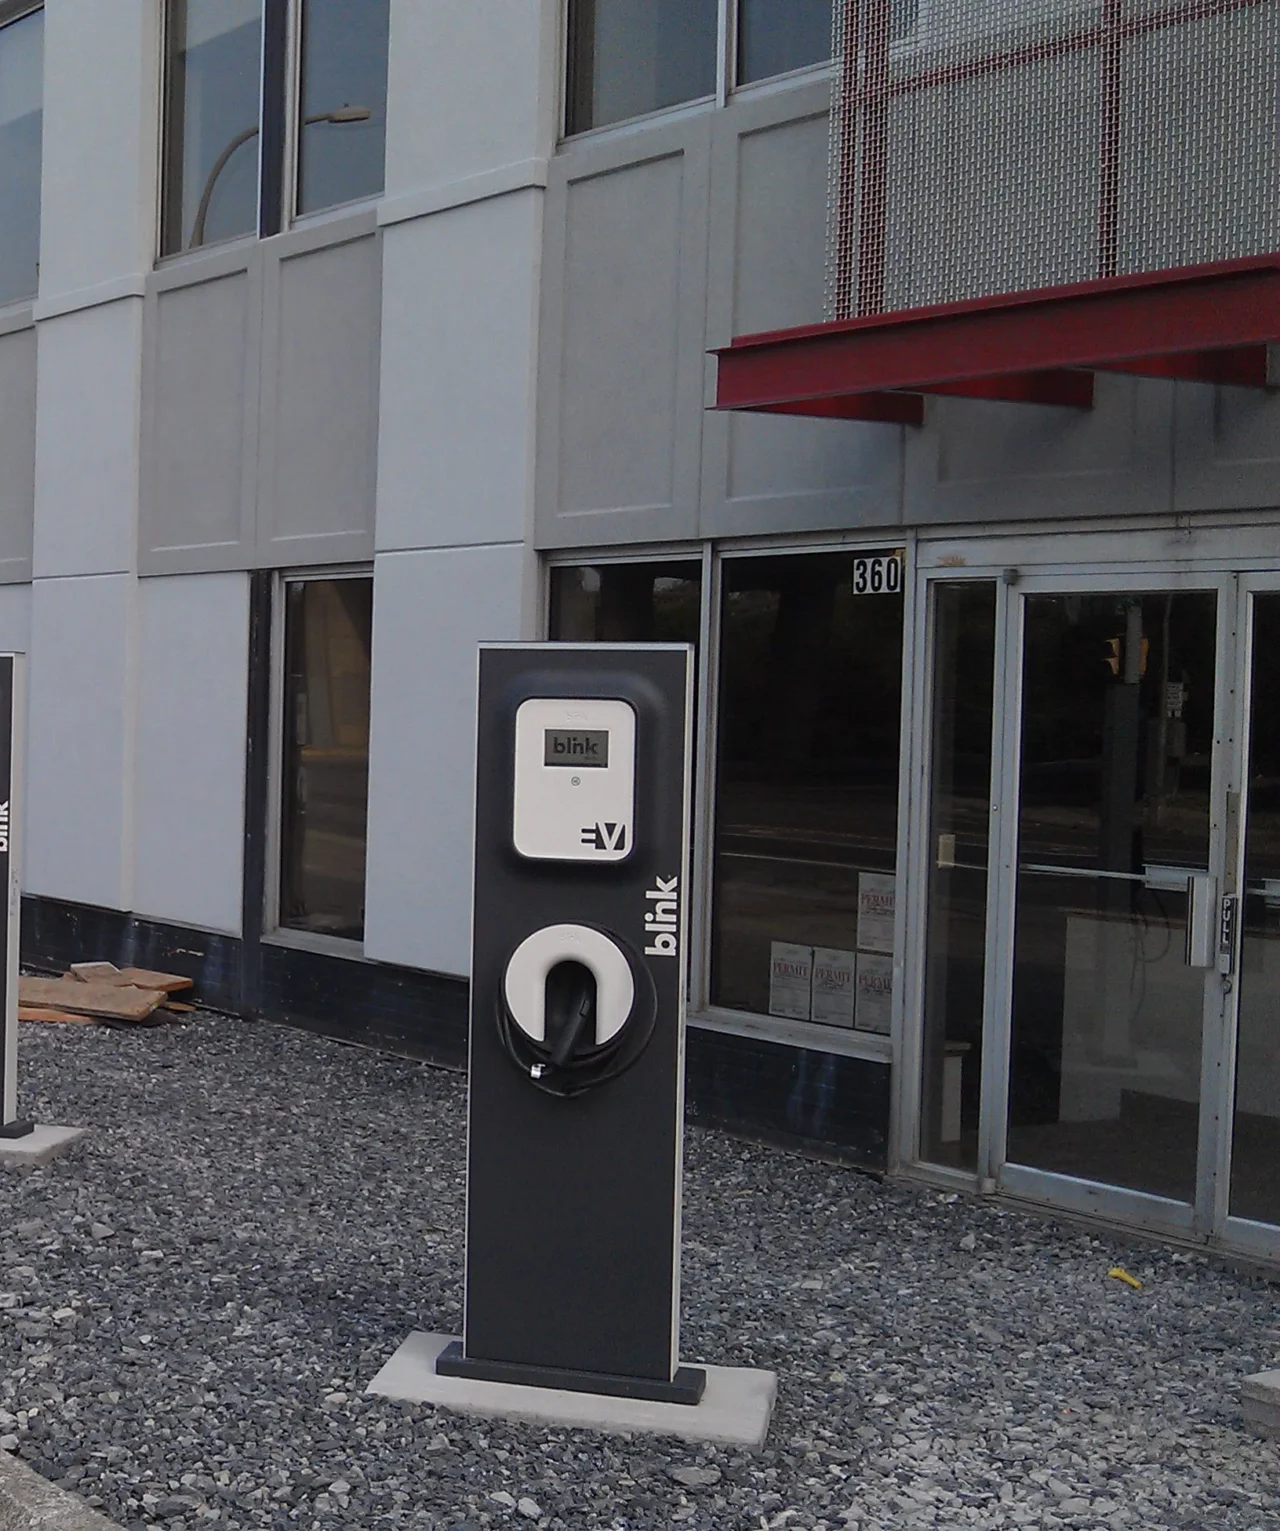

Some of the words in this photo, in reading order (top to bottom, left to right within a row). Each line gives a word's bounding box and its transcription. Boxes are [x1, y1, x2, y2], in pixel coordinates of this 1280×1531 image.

[855, 557, 899, 593] 360
[553, 736, 599, 755] blink
[644, 874, 678, 956] blink
[1222, 898, 1231, 944] PULL
[773, 961, 808, 977] PERMIT
[815, 967, 851, 983] PERMIT
[858, 974, 893, 990] PERMI
